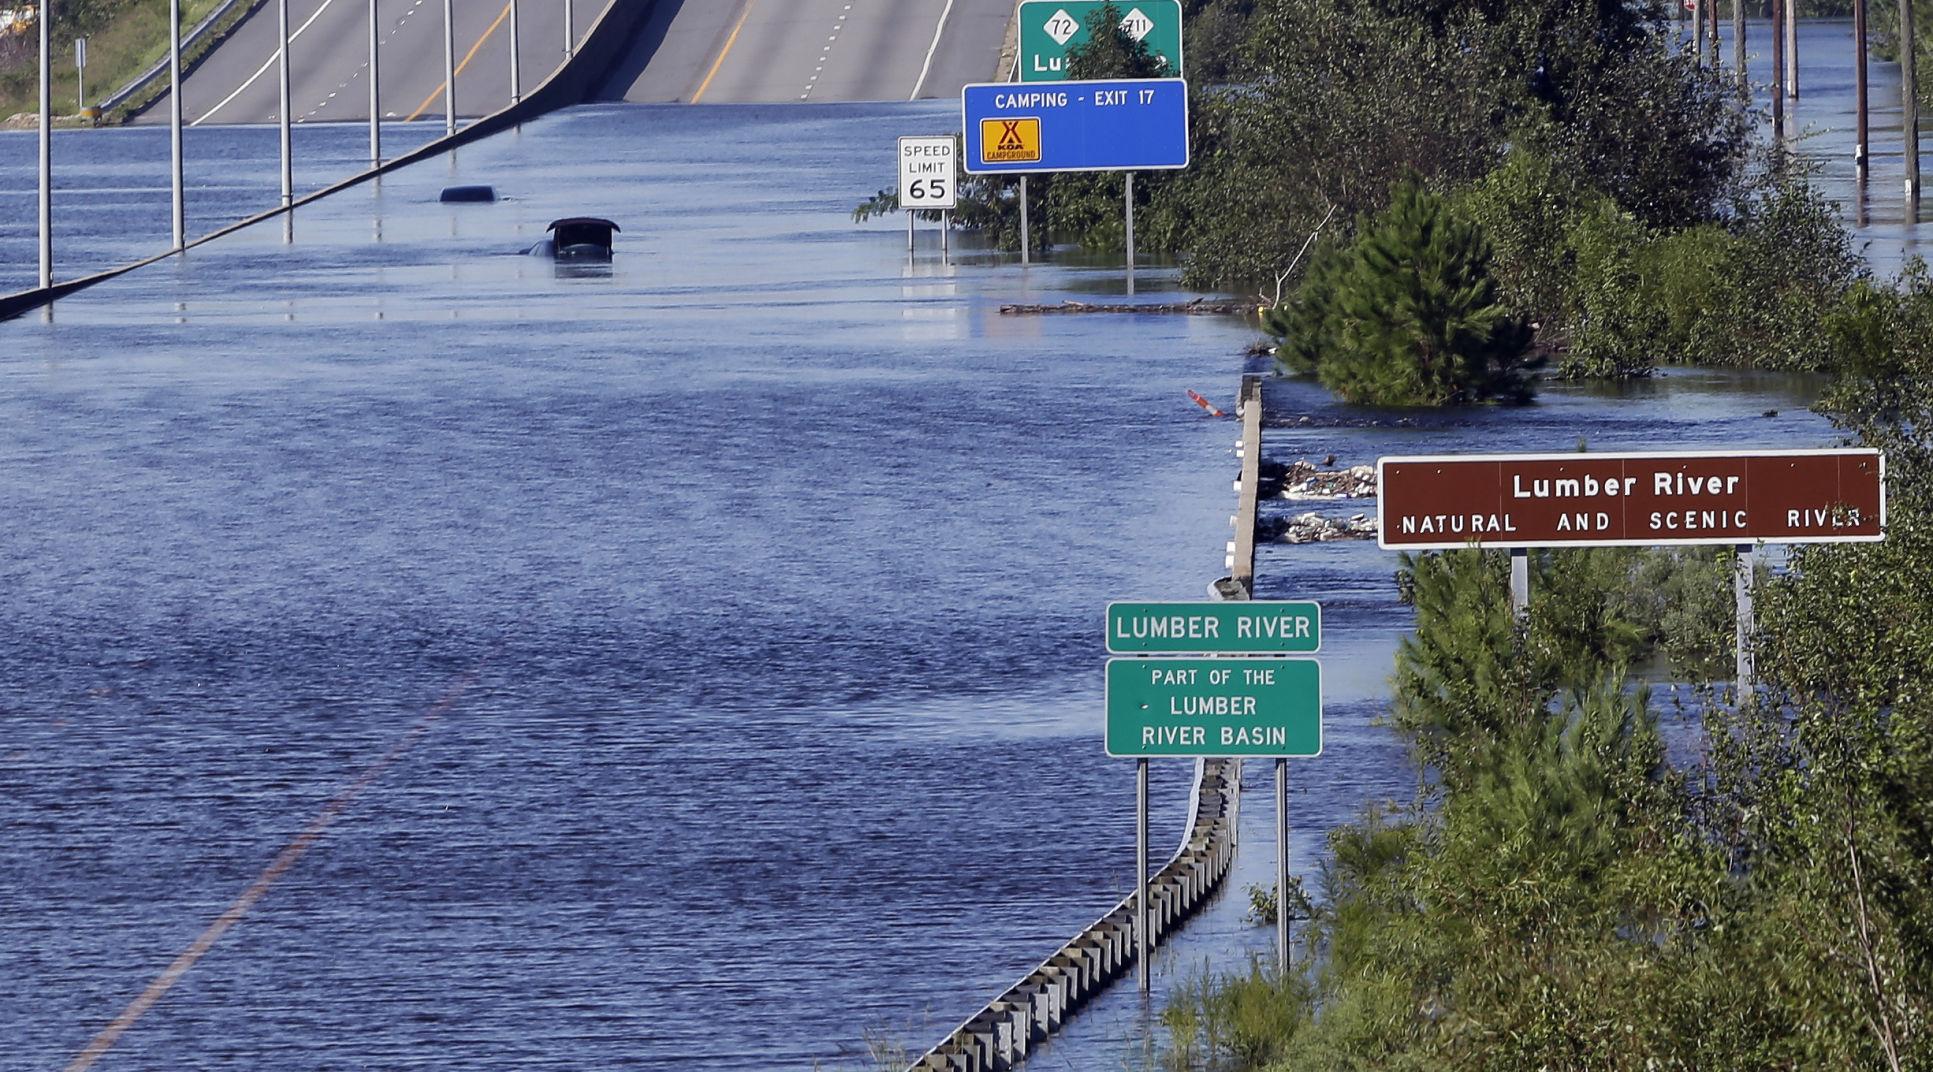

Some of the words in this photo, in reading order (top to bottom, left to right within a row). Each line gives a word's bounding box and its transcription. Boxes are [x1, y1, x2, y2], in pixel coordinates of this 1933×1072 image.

[1051, 19, 1072, 35] 72
[1125, 18, 1146, 31] 711
[995, 92, 1068, 109] CAMPING
[1095, 90, 1128, 106] EXIT
[1138, 89, 1155, 105] 17
[904, 145, 950, 157] SPEED
[986, 150, 1036, 160] CAMPGROUND
[909, 162, 945, 174] LIMIT
[909, 179, 946, 199] 65
[1513, 473, 1638, 499] Lumber
[1654, 470, 1740, 496] River
[1401, 514, 1517, 534] NATURAL
[1556, 512, 1610, 532] AND
[1650, 511, 1748, 530] SCENIC
[1787, 508, 1860, 528] RIVER
[1116, 616, 1220, 639] LUMBER
[1237, 616, 1311, 638] RIVER
[1151, 669, 1198, 686] PART
[1209, 669, 1232, 686] OF
[1243, 669, 1276, 686] THE
[1170, 696, 1257, 716] LUMBER
[1142, 726, 1206, 746] RIVER
[1220, 726, 1287, 746] BASIN
